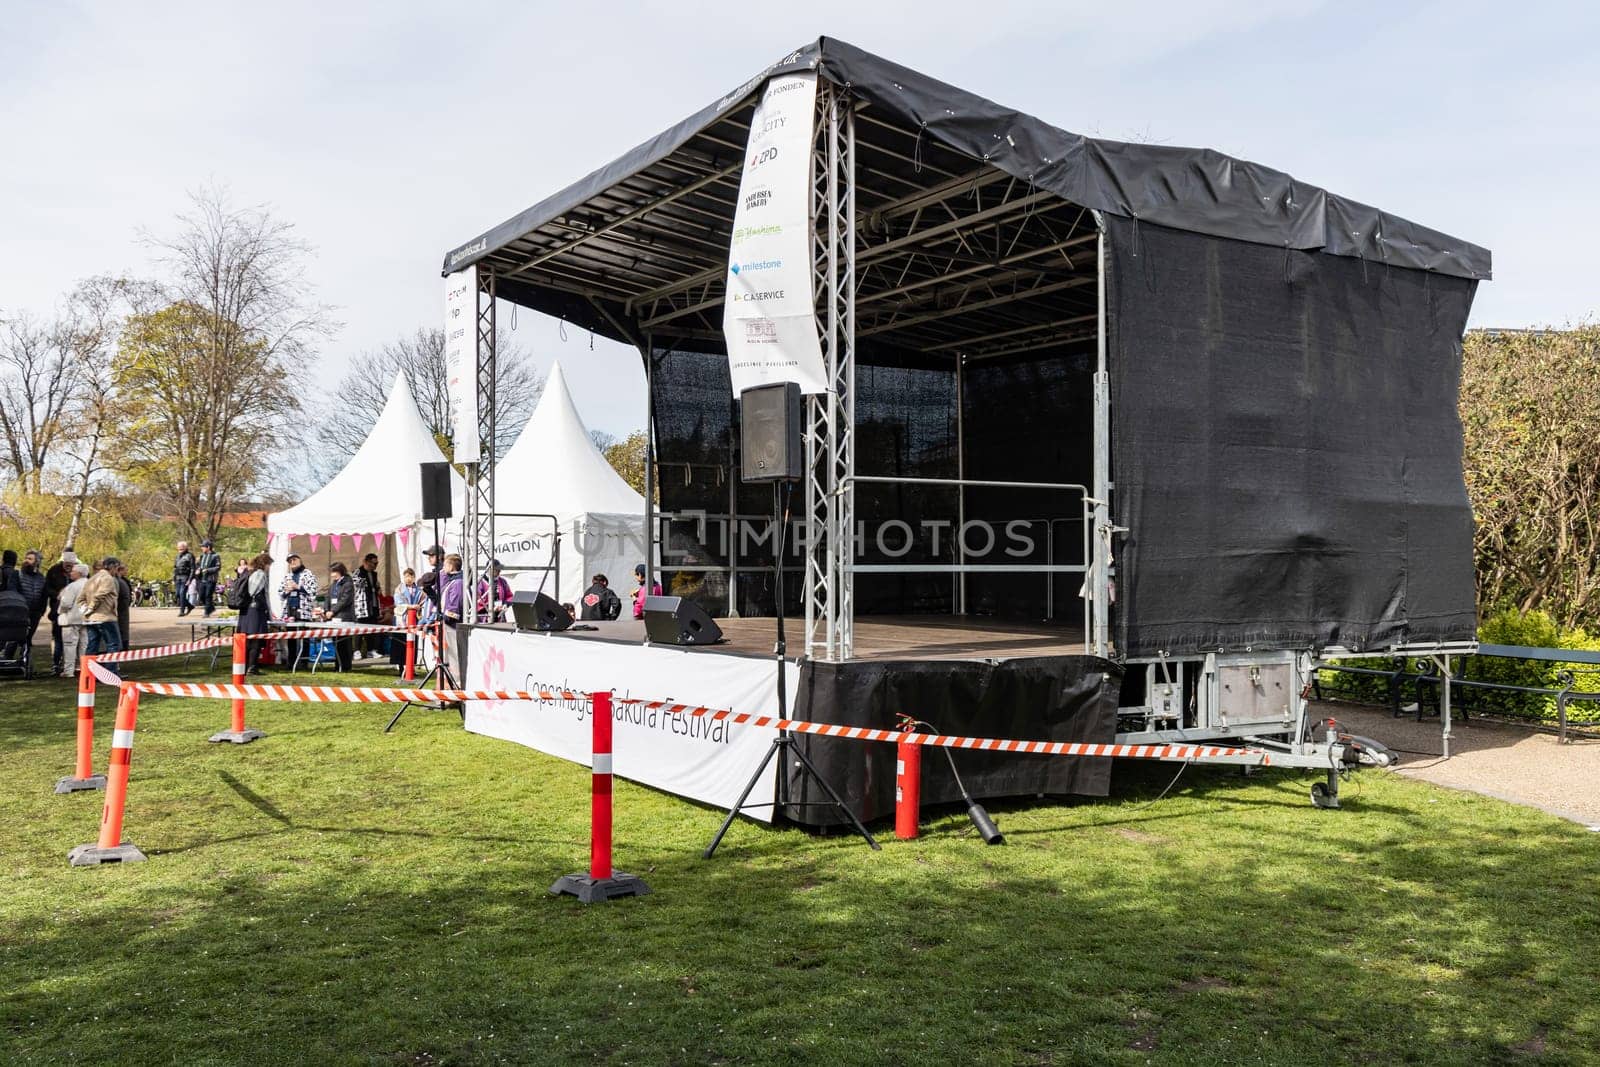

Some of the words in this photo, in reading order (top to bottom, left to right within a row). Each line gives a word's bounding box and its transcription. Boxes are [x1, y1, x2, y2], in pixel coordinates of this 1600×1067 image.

[759, 146, 778, 165] ZPD
[743, 259, 782, 271] milestone
[525, 673, 594, 721] Copenhage
[663, 697, 733, 744] Festival
